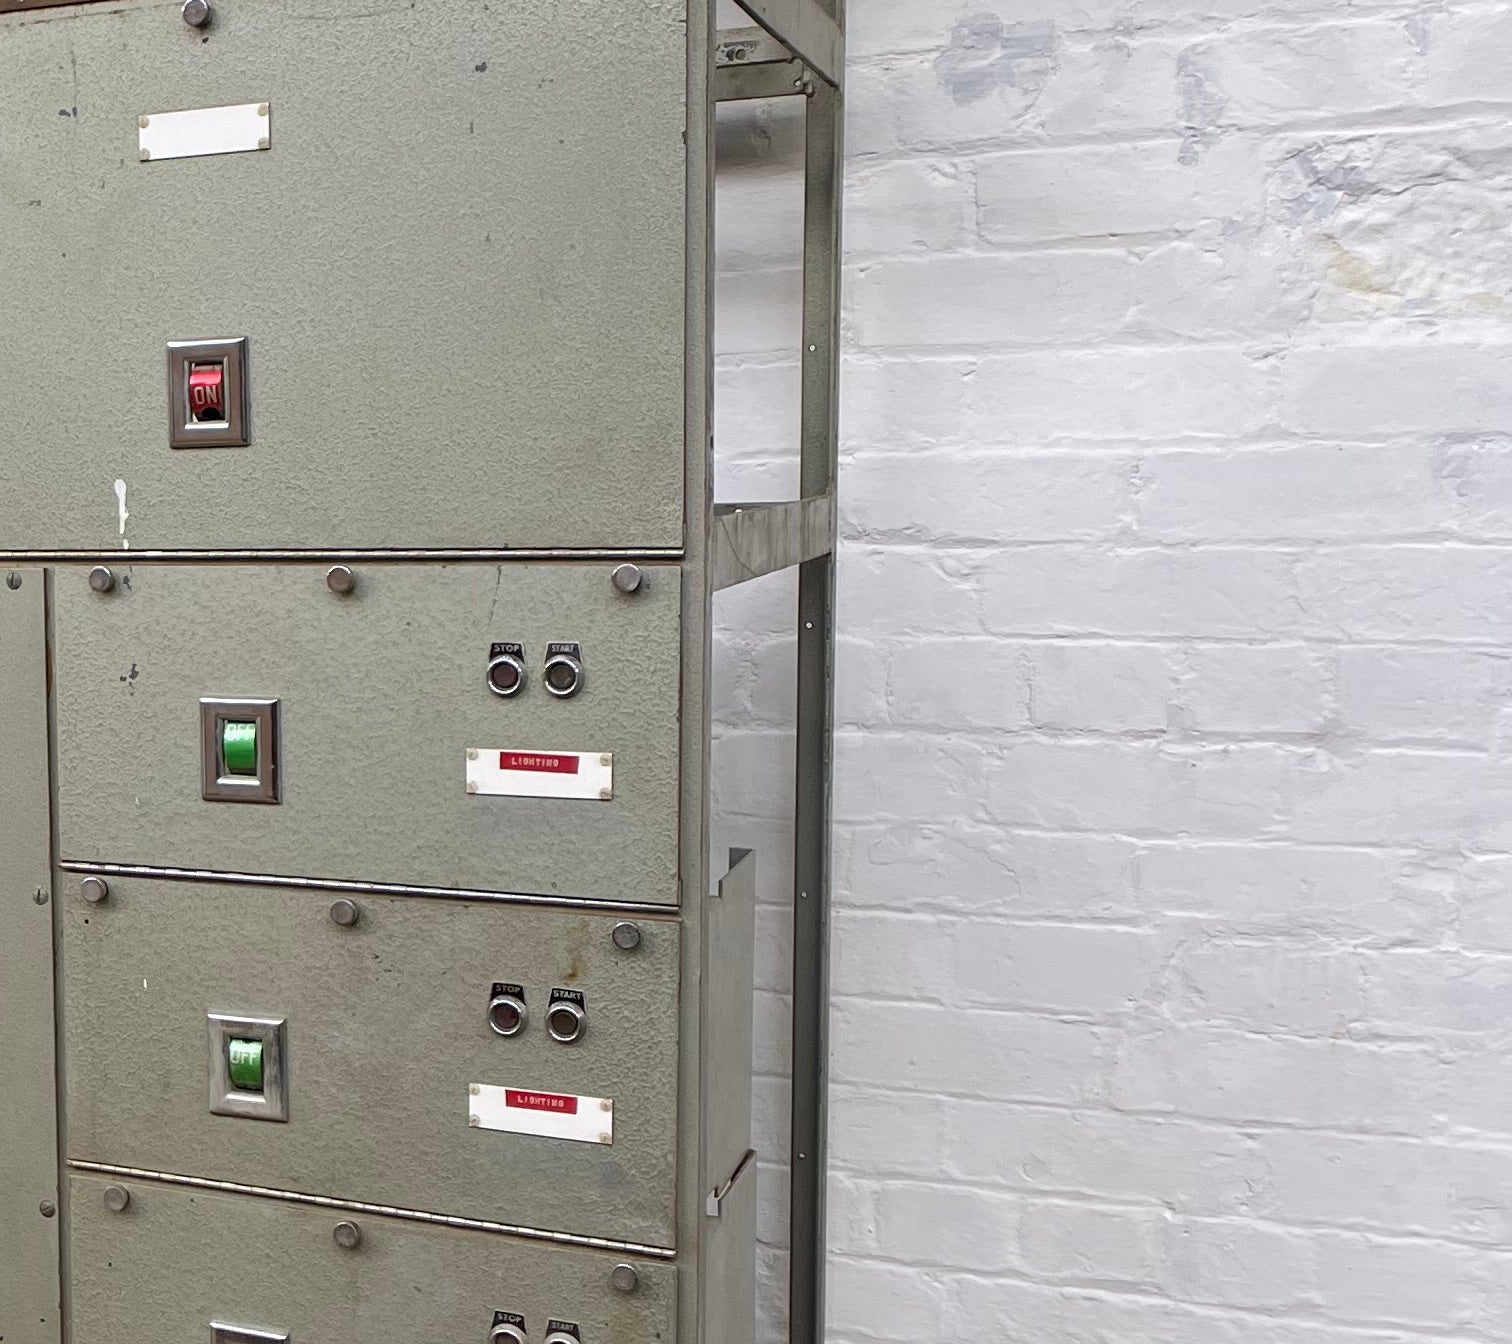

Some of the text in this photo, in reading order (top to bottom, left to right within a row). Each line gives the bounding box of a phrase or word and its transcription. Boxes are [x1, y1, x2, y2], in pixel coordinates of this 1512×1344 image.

[194, 385, 218, 405] ON
[493, 644, 519, 652] STOP
[551, 644, 575, 653] START
[512, 757, 559, 767] LIGHTING
[495, 984, 521, 993] STOP
[552, 989, 582, 1000] START
[230, 1049, 258, 1065] OFF
[517, 1095, 565, 1108] LIGHTING
[497, 1314, 521, 1324] STOP
[551, 1322, 574, 1332] START
